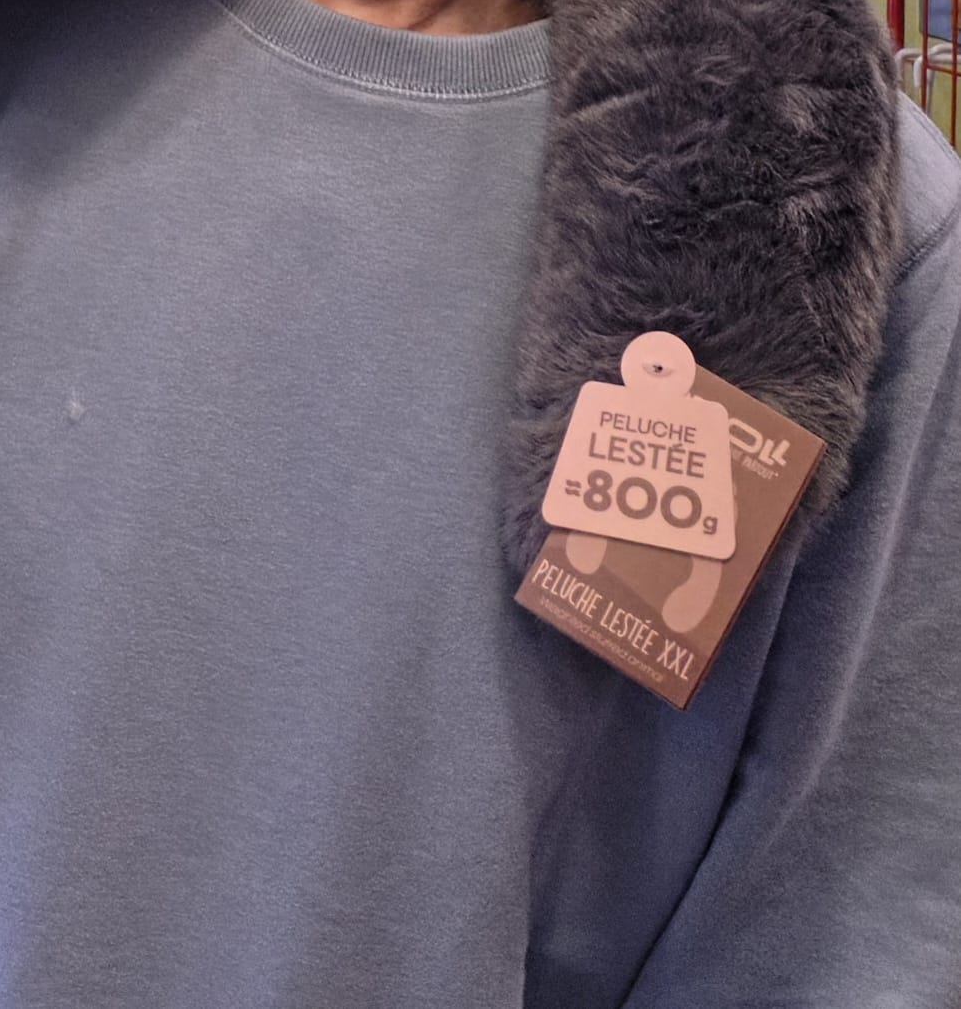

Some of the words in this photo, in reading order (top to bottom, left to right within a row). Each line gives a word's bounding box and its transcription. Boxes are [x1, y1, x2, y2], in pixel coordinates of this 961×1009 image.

[600, 411, 697, 444] PELUCHE
[728, 418, 791, 466] OLL
[588, 432, 707, 478] LESTÉE
[532, 559, 603, 619] PELUCHE
[600, 601, 659, 655] LESTÉE
[656, 639, 695, 681] XXL
